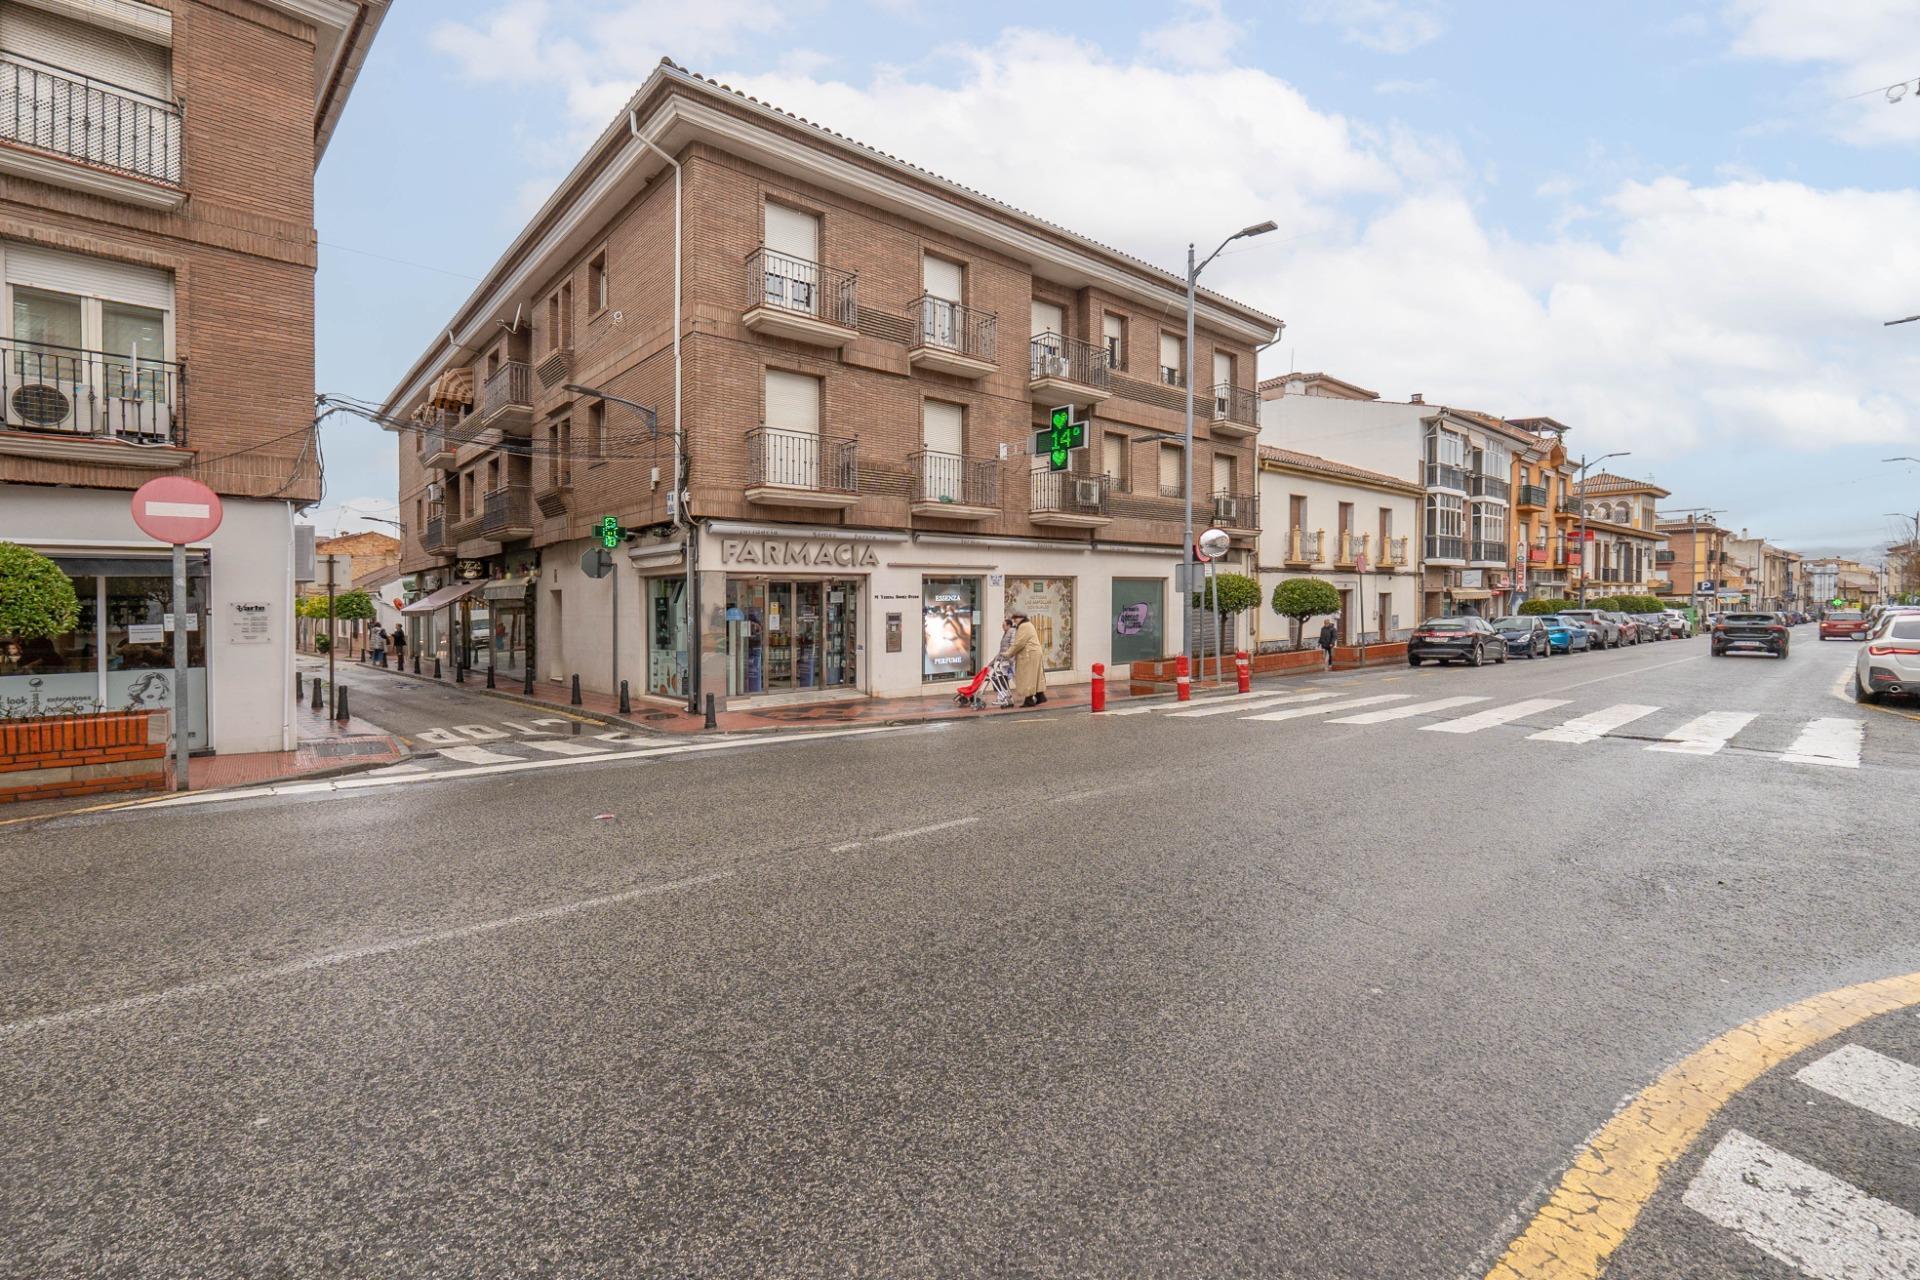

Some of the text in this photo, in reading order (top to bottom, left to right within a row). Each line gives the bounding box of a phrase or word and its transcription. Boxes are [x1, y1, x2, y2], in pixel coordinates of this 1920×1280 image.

[721, 539, 879, 567] FARMACIA
[935, 594, 961, 602] ESSENZA
[934, 656, 962, 665] PERFUME
[7, 696, 28, 705] look
